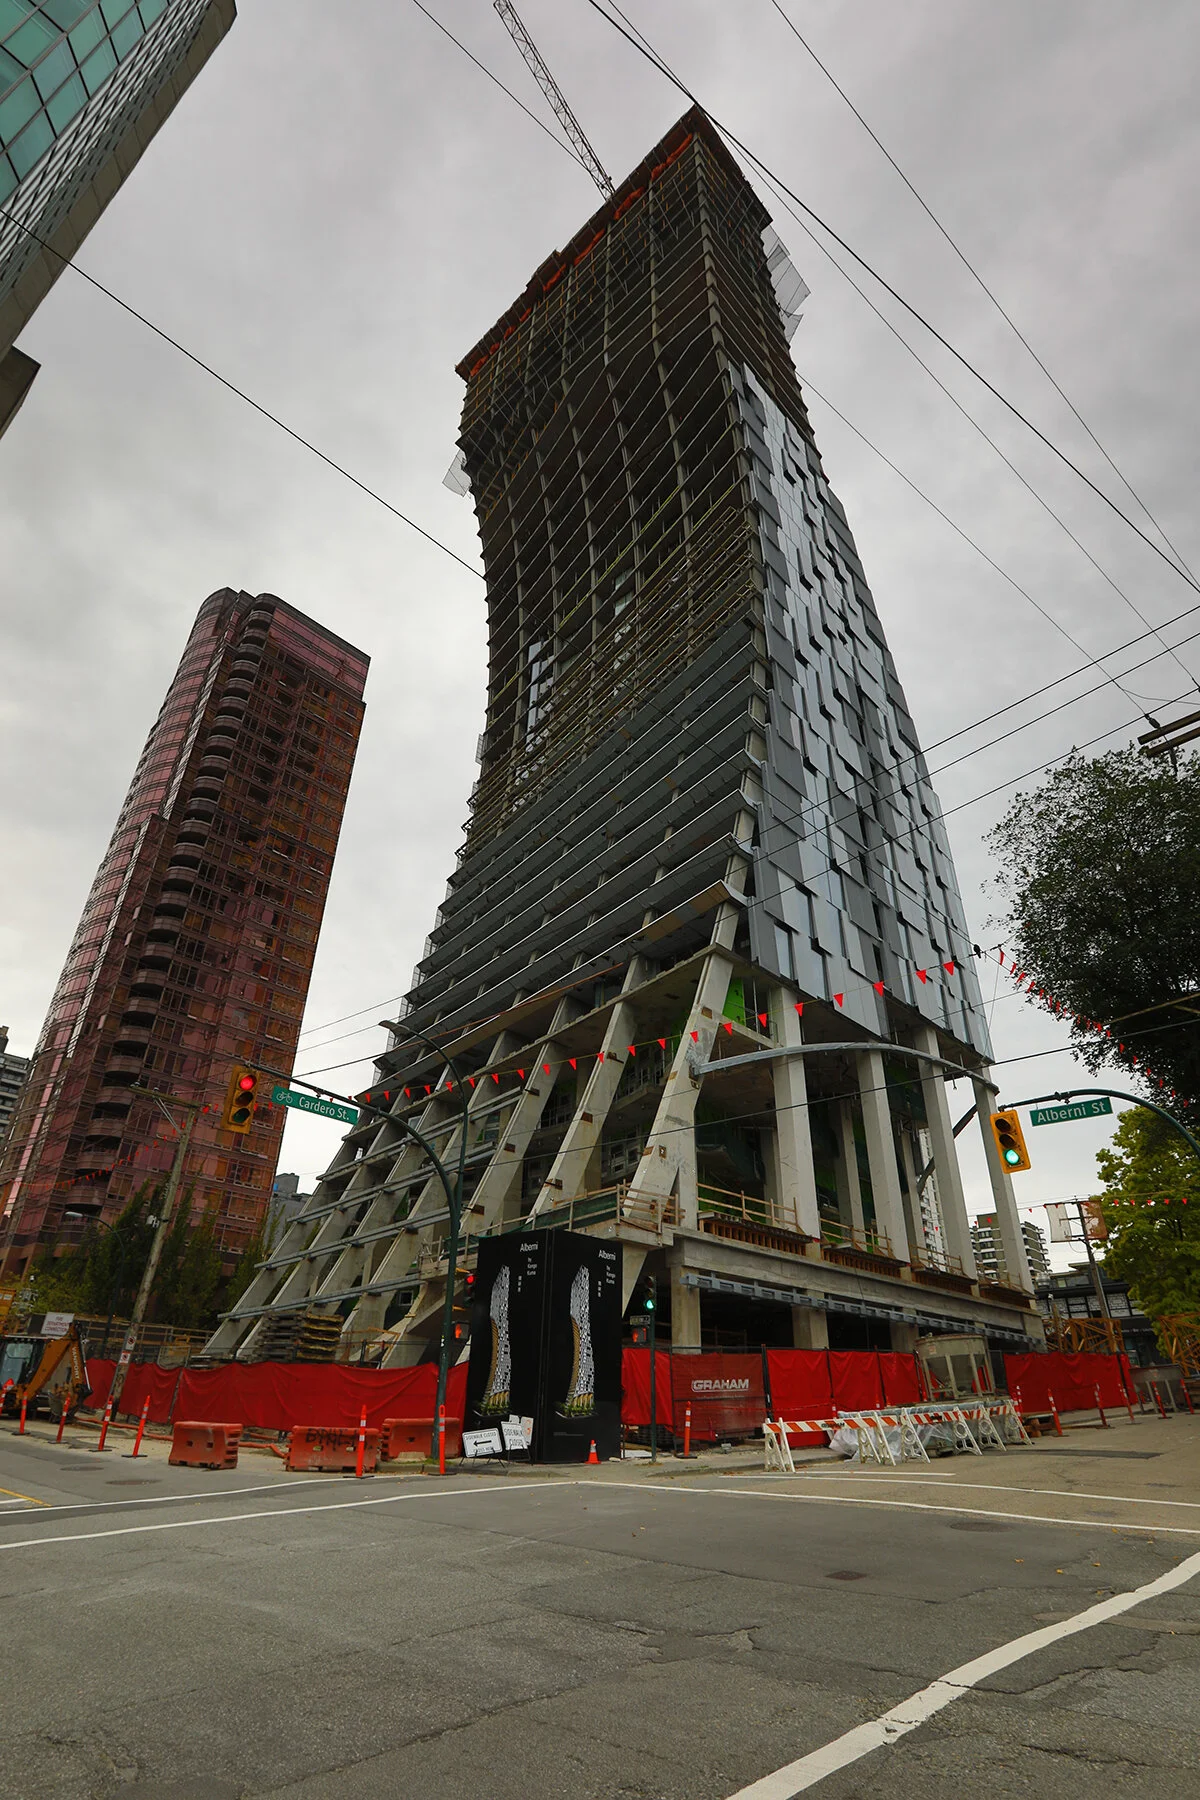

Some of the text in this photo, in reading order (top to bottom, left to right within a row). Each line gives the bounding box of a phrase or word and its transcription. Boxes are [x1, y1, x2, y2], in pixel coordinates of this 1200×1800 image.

[298, 1096, 350, 1121] Cardero St.
[1037, 1101, 1107, 1123] Alberni St
[520, 1241, 539, 1252] Alberni
[598, 1249, 616, 1261] Alberni
[692, 1378, 750, 1391] GRAHAM
